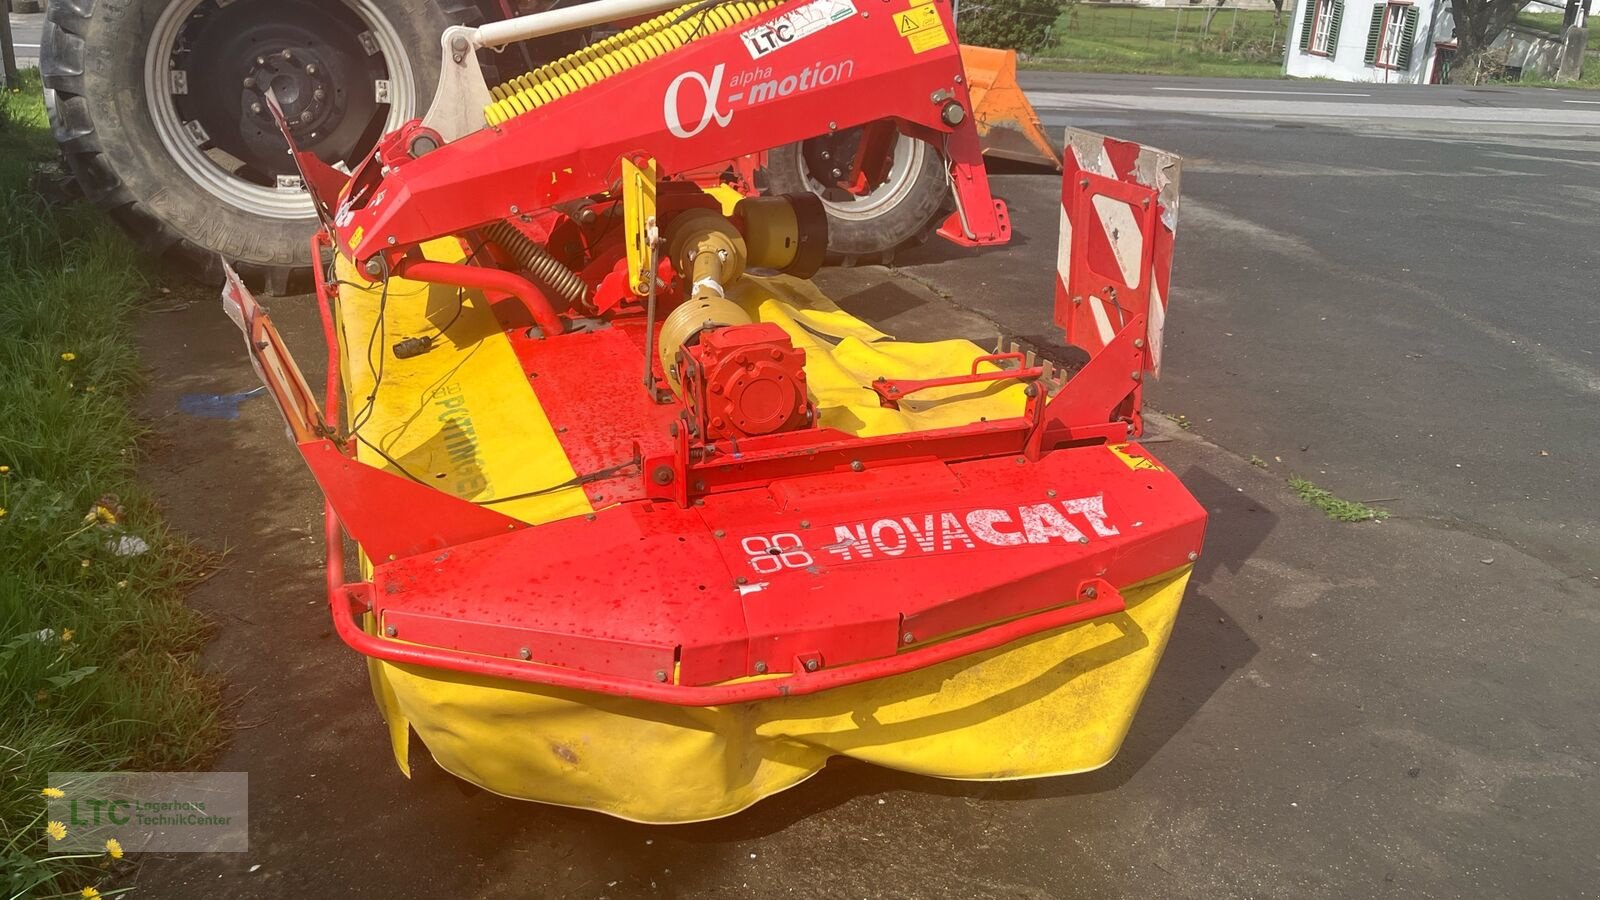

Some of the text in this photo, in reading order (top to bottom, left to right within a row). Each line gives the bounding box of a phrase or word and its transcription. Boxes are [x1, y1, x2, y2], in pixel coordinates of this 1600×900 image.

[751, 24, 795, 55] LTC
[729, 66, 773, 88] alpha
[826, 494, 1120, 561] NOVACAT
